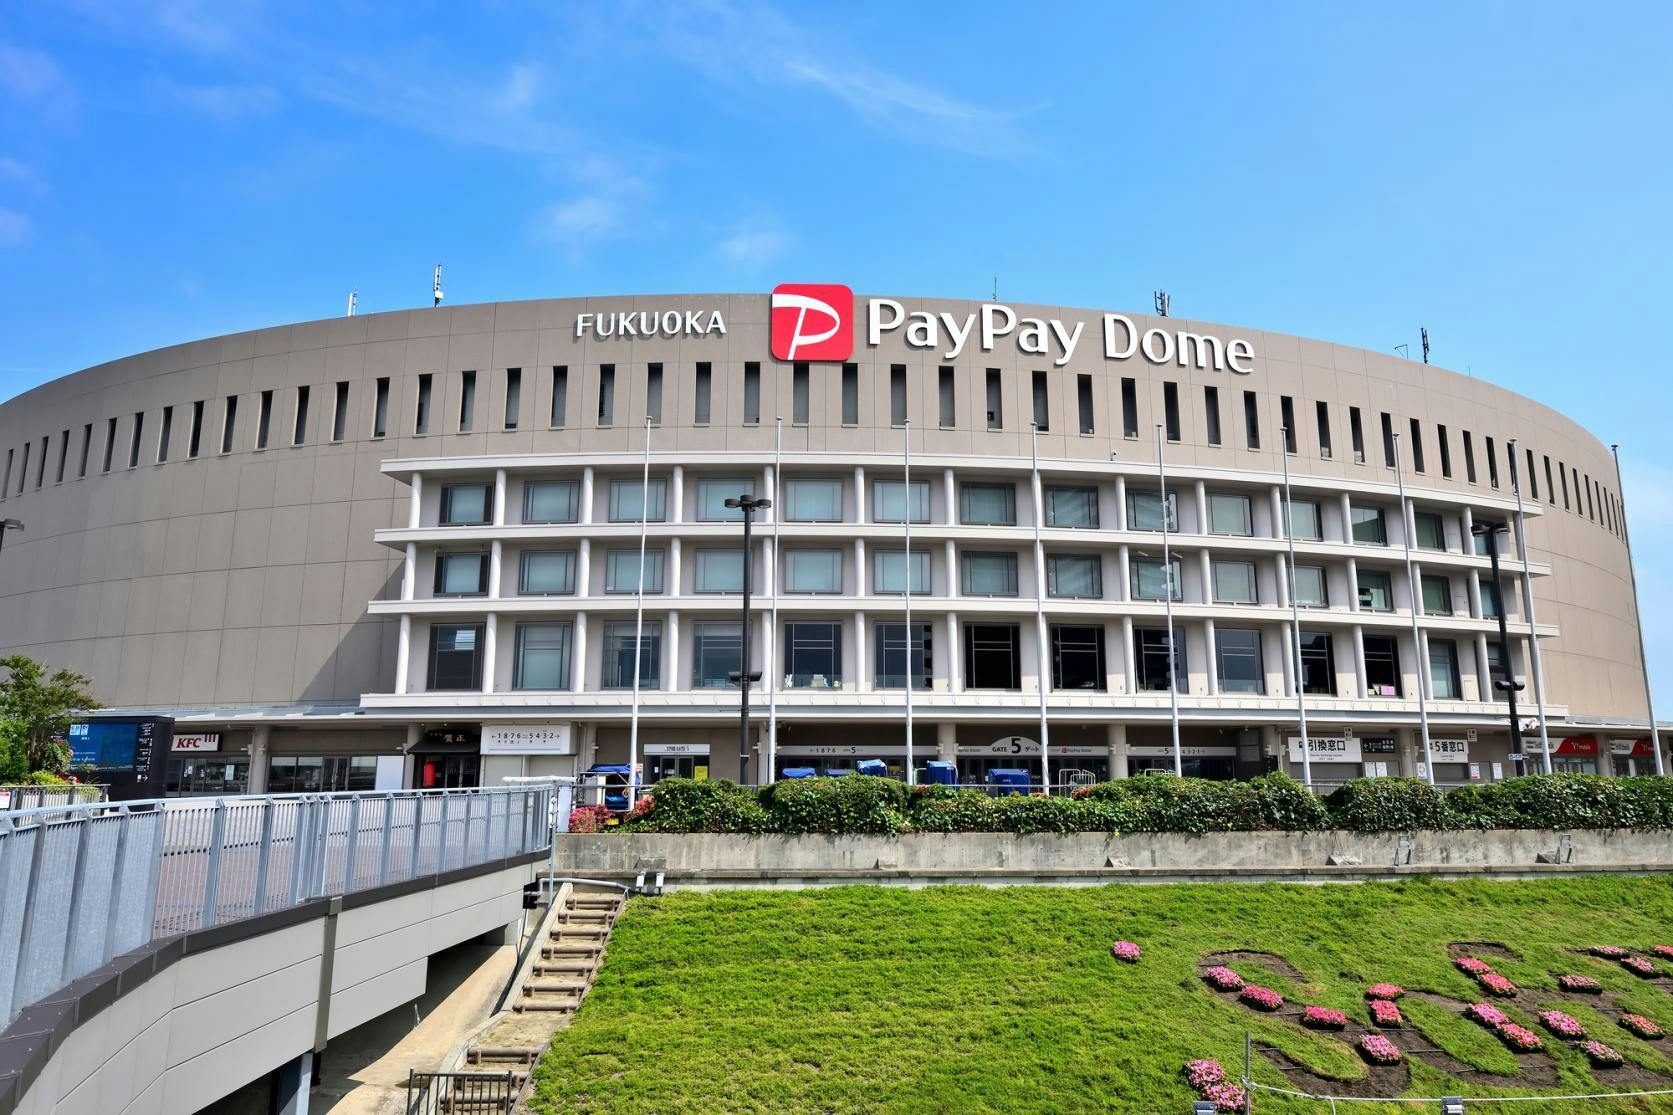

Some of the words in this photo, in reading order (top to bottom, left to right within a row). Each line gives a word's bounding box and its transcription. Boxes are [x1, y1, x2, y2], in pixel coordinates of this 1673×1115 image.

[575, 309, 727, 338] FUKUOKA
[867, 297, 1084, 367] PayPay
[1103, 312, 1255, 374] Dome
[176, 737, 202, 749] KFC
[1011, 737, 1021, 754] 5
[1298, 738, 1346, 752] 引換窓口
